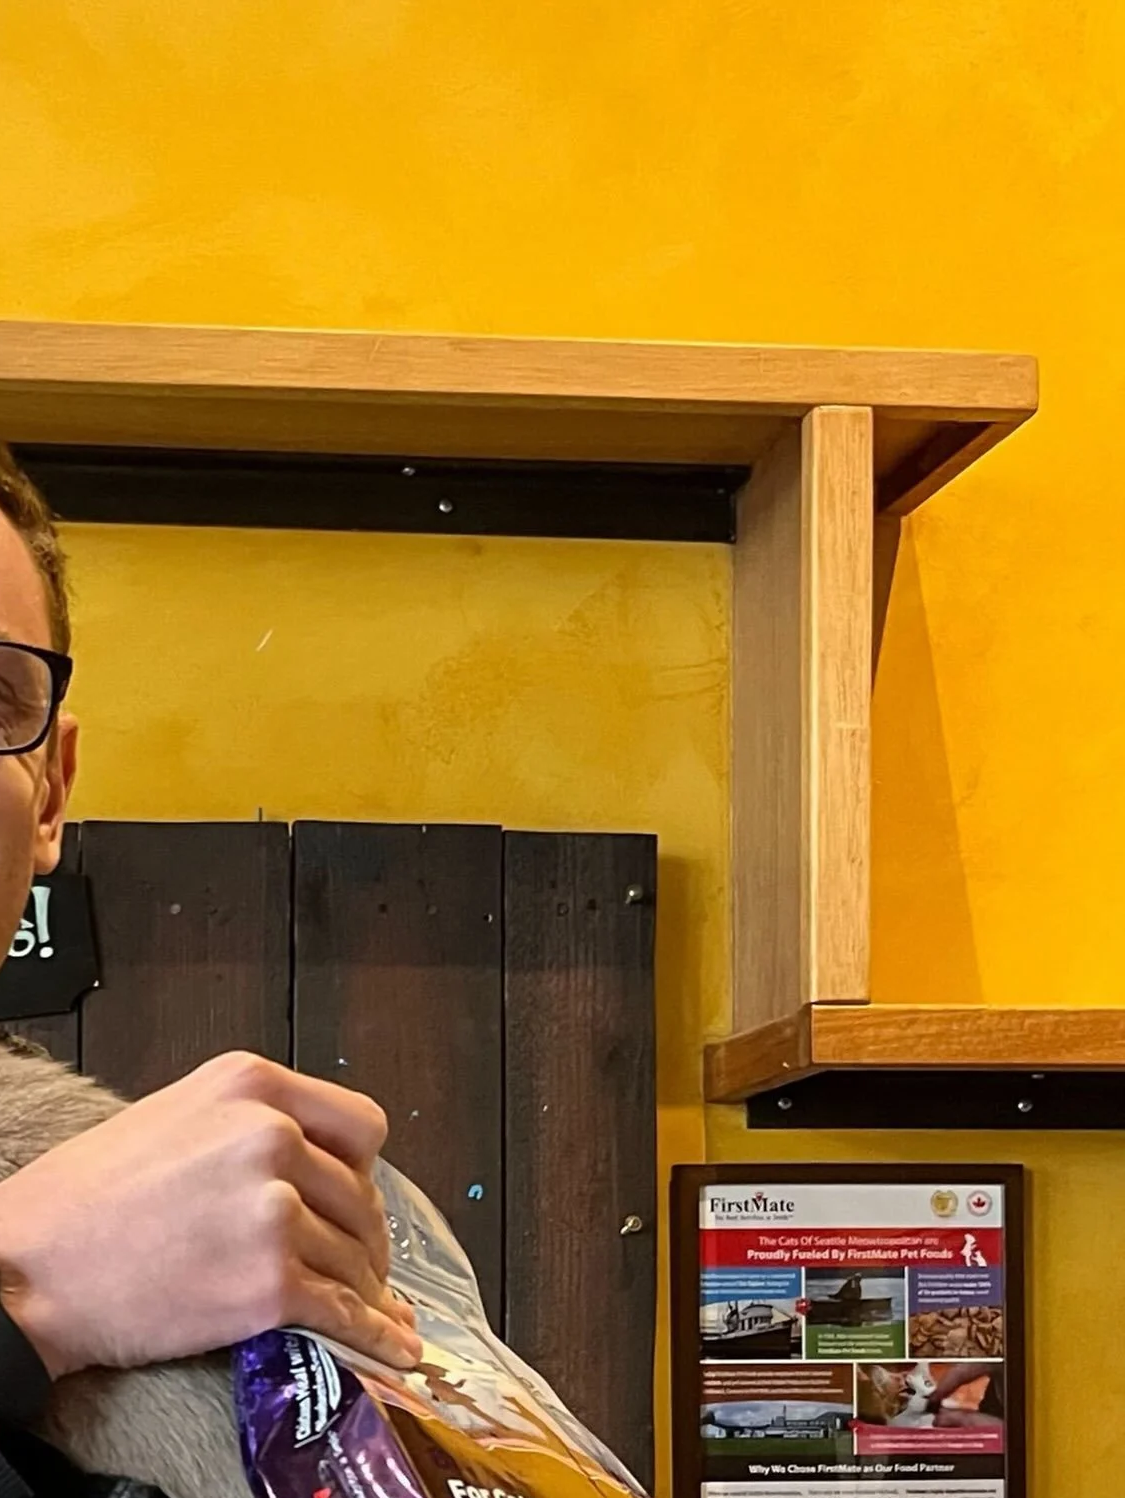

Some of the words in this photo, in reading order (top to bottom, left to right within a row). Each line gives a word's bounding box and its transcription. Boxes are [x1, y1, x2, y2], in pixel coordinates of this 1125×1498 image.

[710, 1196, 795, 1213] FirstMate
[747, 1249, 791, 1262] Proudly
[748, 1464, 770, 1475] Why
[771, 1464, 786, 1473] We
